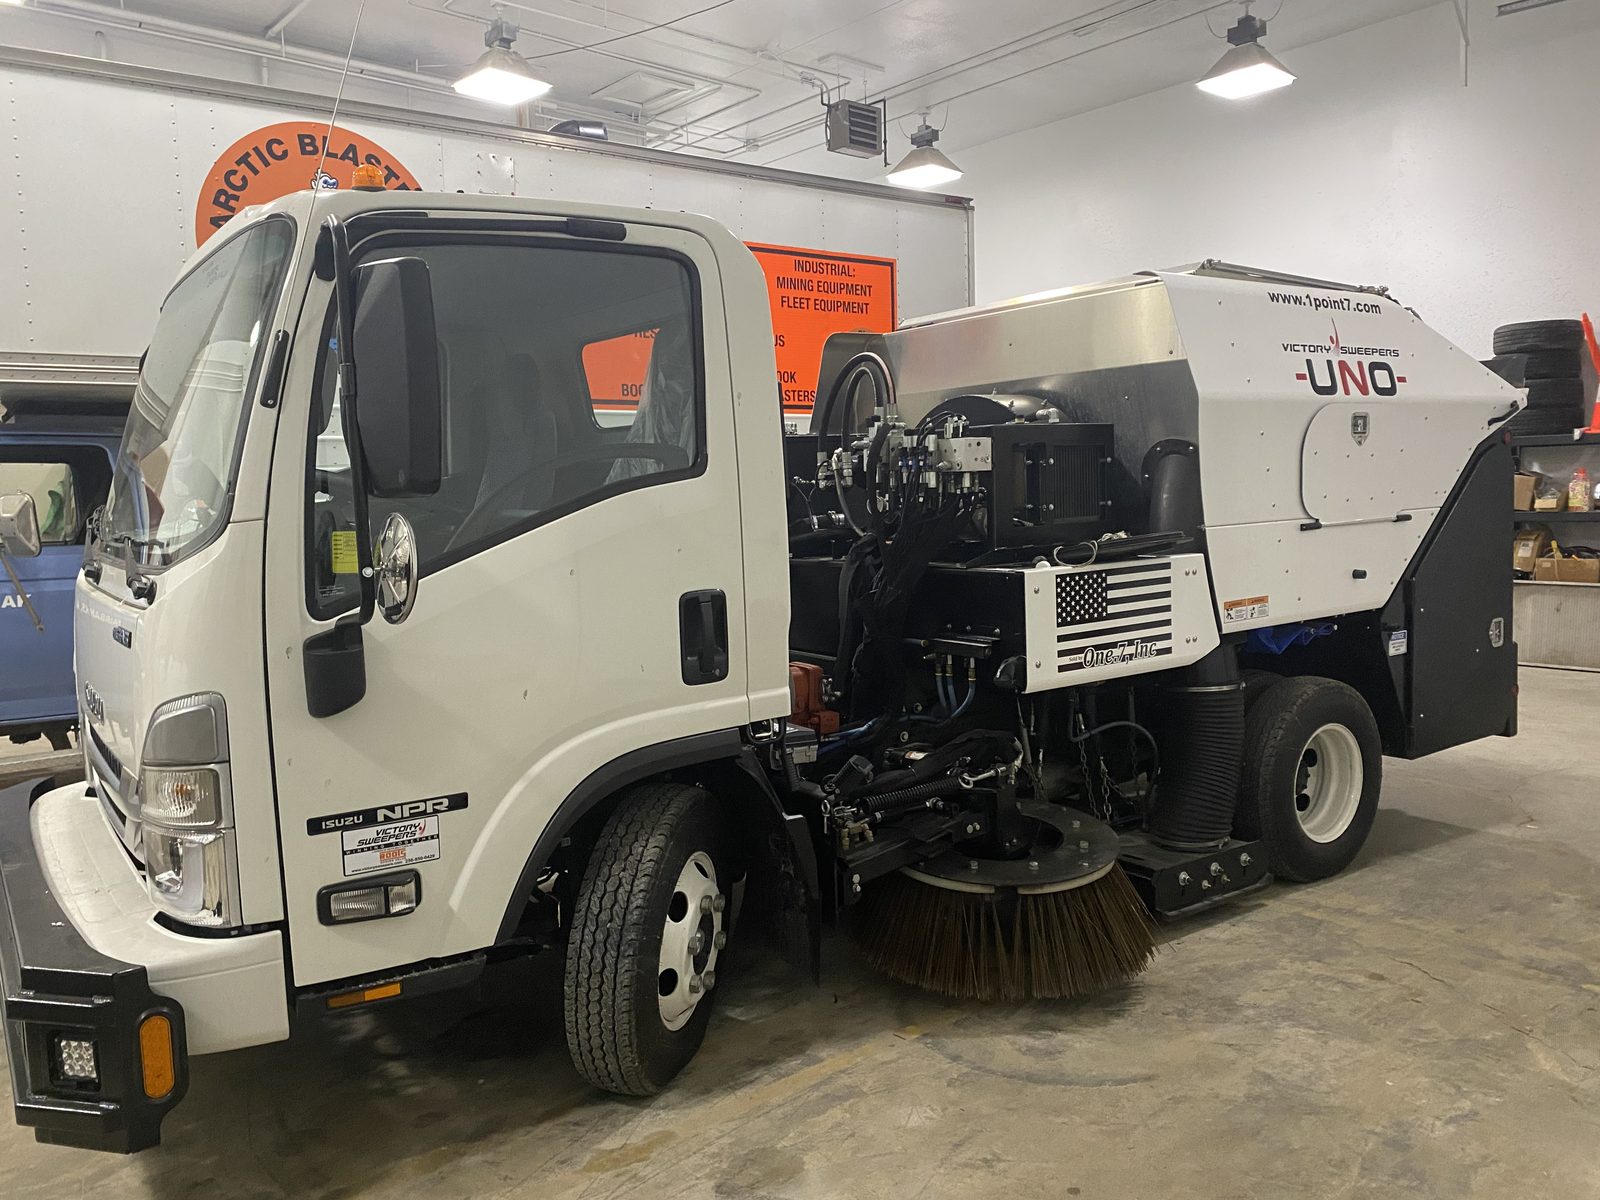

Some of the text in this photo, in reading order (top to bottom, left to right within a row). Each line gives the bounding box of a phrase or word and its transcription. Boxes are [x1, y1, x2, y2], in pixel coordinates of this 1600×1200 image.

[209, 133, 423, 229] ARCTIC BLAST
[794, 259, 856, 277] INDUSTRIAL:
[776, 276, 873, 297] MINING EQUIPMENT
[780, 296, 870, 315] FLEET EQUIPMENT
[1267, 291, 1382, 315] www.1point7.com
[1281, 342, 1399, 357] VICTORY SWEEPERS
[1305, 358, 1398, 397] UNO
[1134, 640, 1157, 660] Inc
[322, 798, 449, 829] ISUZU NPR
[357, 831, 417, 847] SWEEPERS
[375, 821, 421, 837] VICTORY
